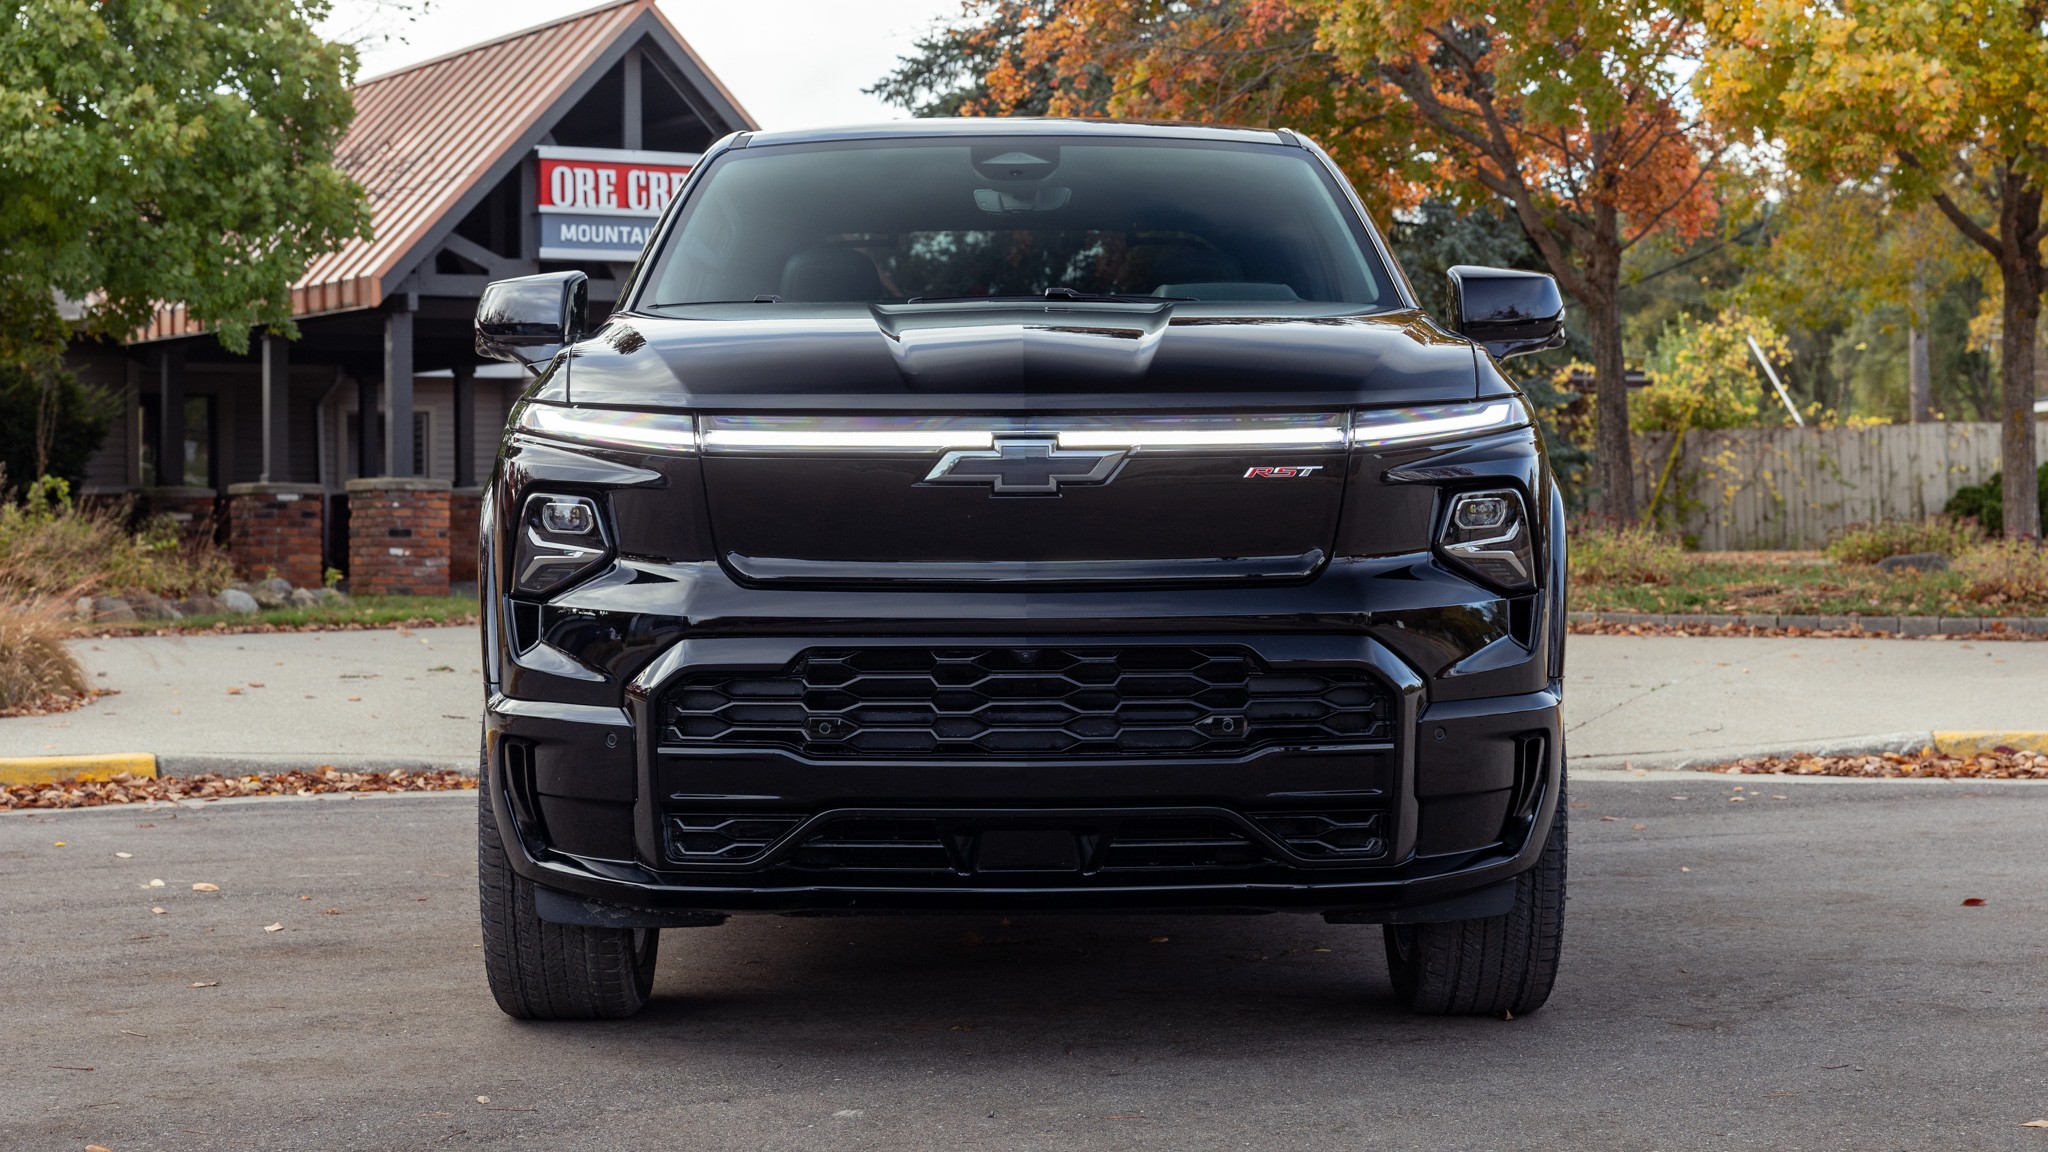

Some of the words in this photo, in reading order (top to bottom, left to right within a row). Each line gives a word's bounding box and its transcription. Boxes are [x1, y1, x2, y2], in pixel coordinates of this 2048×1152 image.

[551, 166, 618, 209] ORE
[560, 223, 654, 244] MOUNTAI
[1243, 466, 1323, 478] RST
